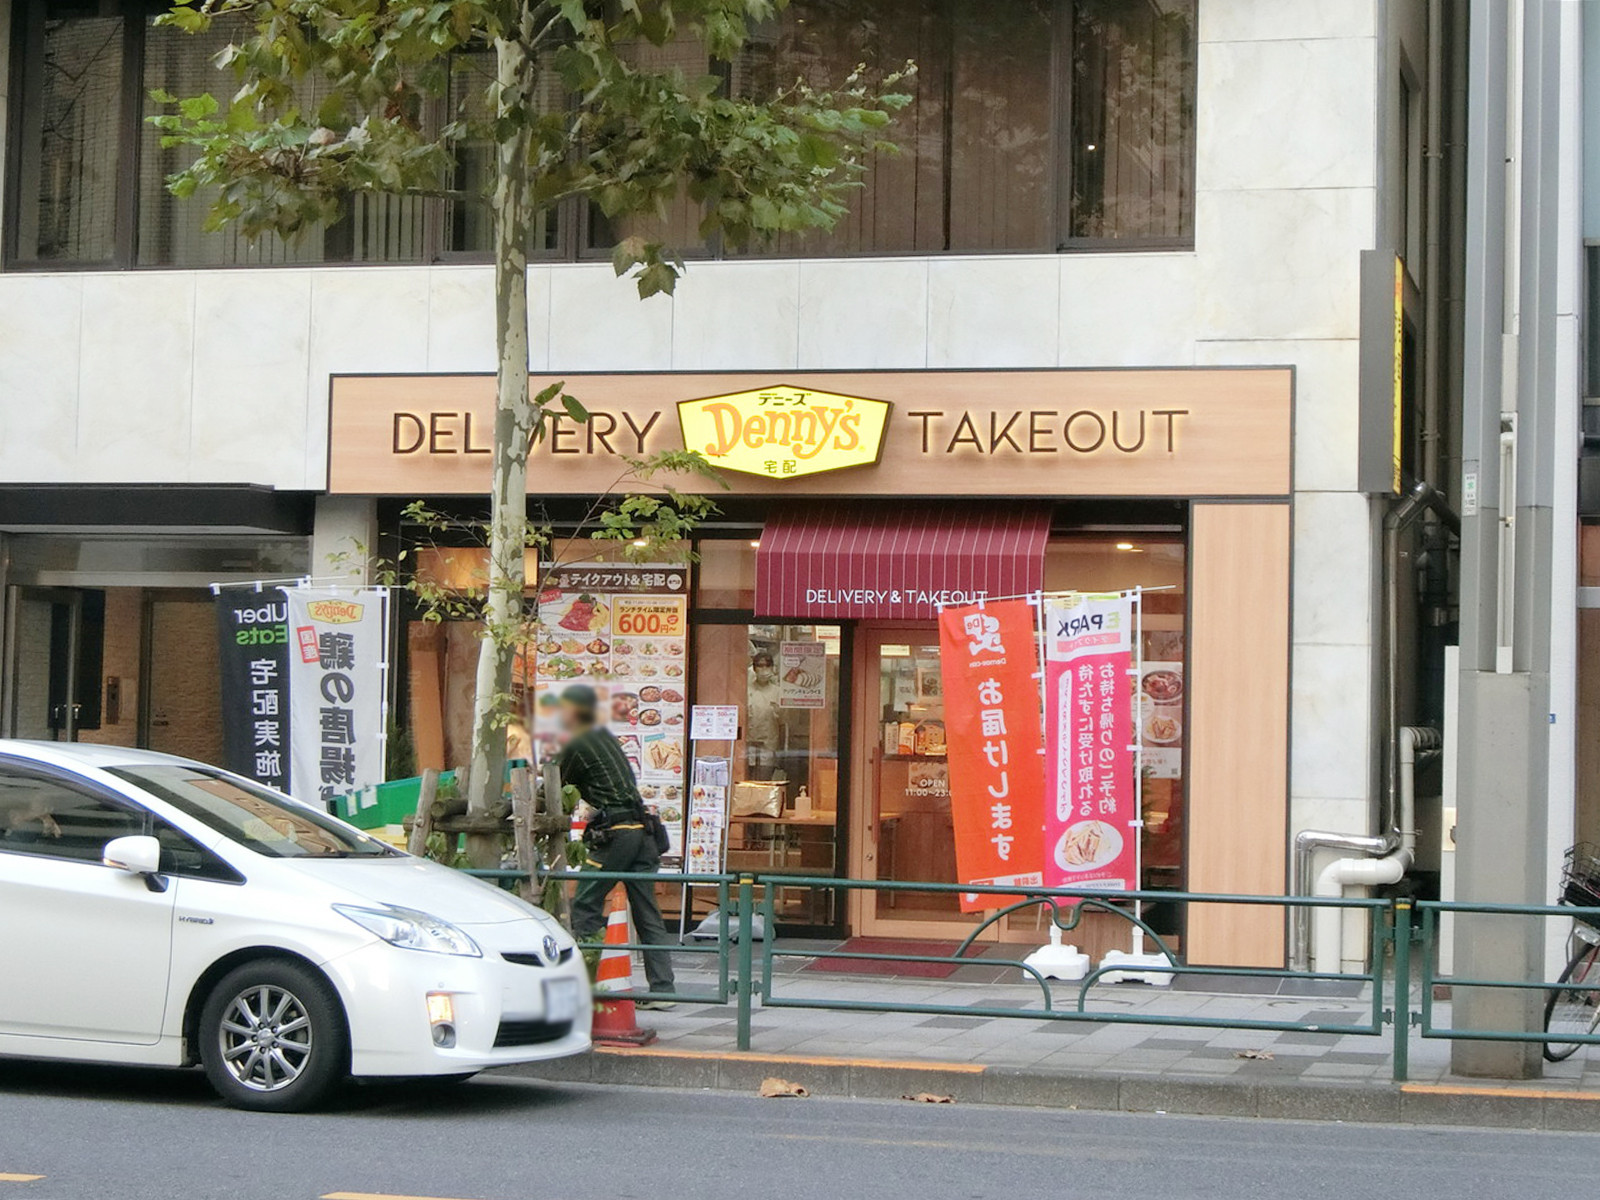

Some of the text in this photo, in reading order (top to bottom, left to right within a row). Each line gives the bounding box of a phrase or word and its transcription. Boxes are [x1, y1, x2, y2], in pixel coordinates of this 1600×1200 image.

[759, 392, 812, 406] デニーズ
[393, 411, 661, 454] DELERY
[702, 399, 861, 460] Denny's
[907, 410, 1189, 454] TAKEOUT
[764, 460, 797, 474] 宅配
[806, 589, 989, 605] DELIVERY & TAKEOUT
[920, 778, 945, 787] OPEN
